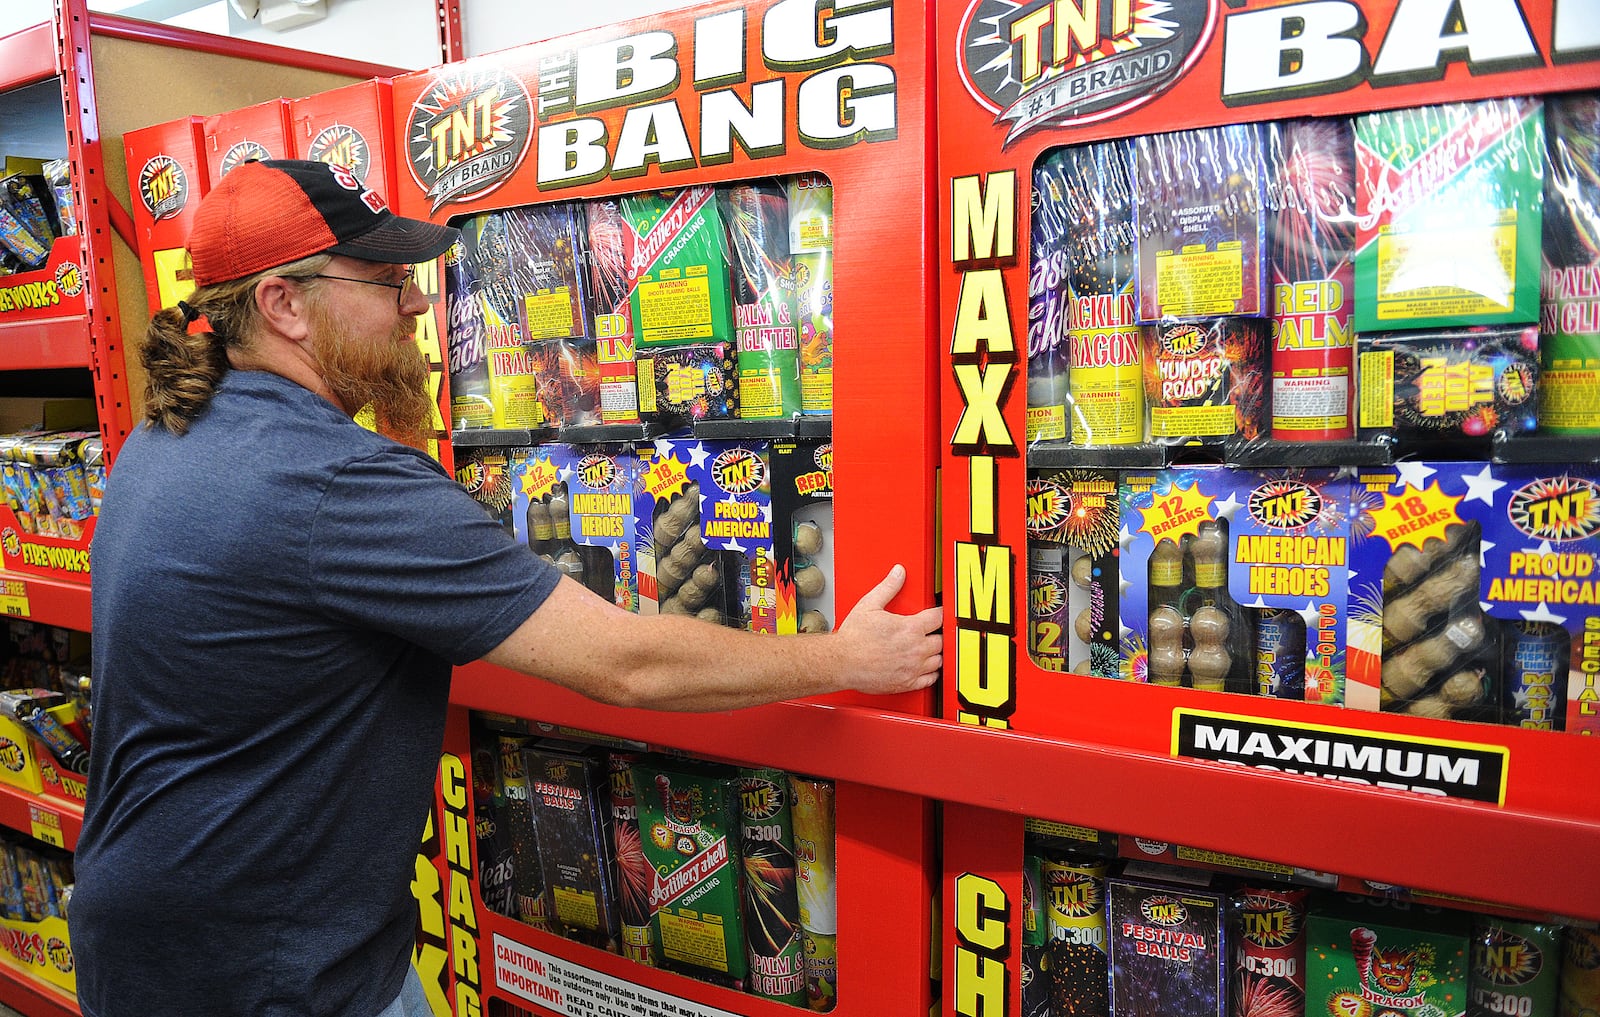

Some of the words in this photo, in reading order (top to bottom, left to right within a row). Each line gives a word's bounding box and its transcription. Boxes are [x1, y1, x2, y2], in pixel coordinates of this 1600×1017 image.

[538, 49, 577, 122] THE
[574, 0, 895, 112] BIG
[1028, 86, 1057, 118] #1
[1069, 50, 1173, 98] BRAND
[430, 83, 500, 172] TNT
[536, 61, 898, 191] BANG
[461, 151, 514, 181] BRAND
[150, 166, 175, 204] TNT
[1178, 204, 1220, 217] ASSORTED
[1180, 213, 1212, 225] DISPLAY
[663, 216, 706, 266] CRACKLING
[1183, 224, 1208, 233] SHELL
[1182, 254, 1215, 263] WARNING
[62, 268, 79, 291] TNT
[658, 280, 688, 289] WARNING
[1274, 279, 1344, 315] RED
[596, 313, 627, 339] ED
[777, 302, 791, 325] &
[1171, 330, 1199, 352] TNT
[1272, 316, 1355, 351] PALM
[1071, 331, 1140, 369] RAGON
[1080, 391, 1121, 399] WARNING
[1162, 379, 1206, 400] ROAD
[1284, 379, 1331, 387] WARNING
[453, 404, 484, 412] CAUTION
[946, 169, 1019, 728] MAXIMU
[455, 462, 477, 482] TNT
[529, 465, 543, 482] 12
[584, 460, 609, 482] TNT
[651, 471, 684, 495] BREAKS
[653, 463, 673, 482] 18
[721, 457, 752, 487] TNT
[796, 472, 826, 495] RED
[526, 474, 555, 495] BREAKS
[573, 493, 631, 515] AMERICAN
[714, 501, 758, 519] PROUD
[1027, 490, 1058, 518] NT
[1081, 496, 1106, 509] SHELL
[1158, 496, 1187, 519] 12
[1262, 490, 1305, 523] TNT
[1391, 496, 1428, 521] 18
[1529, 488, 1591, 532] TNT
[581, 515, 624, 538] HEROES
[704, 520, 770, 539] AMERICAN
[1151, 506, 1205, 536] BREAKS
[1386, 508, 1452, 540] BREAKS
[22, 542, 91, 573] FIREWORKS
[1234, 533, 1347, 567] AMERICAN
[1509, 551, 1595, 577] PROUD
[755, 546, 768, 617] SPECIAL
[1248, 565, 1331, 598] HEROES
[1316, 603, 1338, 695] SPECIAL
[1578, 616, 1600, 716] SPECIAL
[1193, 724, 1480, 787] MAXIMUM
[534, 781, 583, 801] FESTIVAL
[544, 795, 575, 811] BALLS
[667, 819, 701, 834] DRAGON
[682, 877, 720, 907] CRACKLING
[1052, 881, 1092, 906] TNT
[1150, 903, 1177, 918] TNT
[1242, 909, 1290, 935] TNT
[955, 871, 1010, 1017] CH
[1050, 919, 1103, 945] No.300
[1122, 922, 1207, 951] FESTIVAL
[497, 943, 547, 978] CAUTION:
[753, 953, 790, 975] PALM
[1135, 940, 1192, 963] BALLS
[498, 966, 563, 1006] IMPORTANT:
[548, 962, 562, 976] This
[563, 969, 602, 990] assortment
[604, 983, 636, 1001] contains
[637, 993, 659, 1008] items
[661, 1000, 677, 1014] that
[549, 973, 562, 986] Use
[563, 979, 595, 998] outdoors
[596, 991, 613, 1005] only.
[615, 996, 630, 1009] Use
[631, 1001, 647, 1017] only
[1361, 987, 1425, 1009] DRAGON
[566, 993, 594, 1011] READ
[567, 1004, 583, 1016] ON
